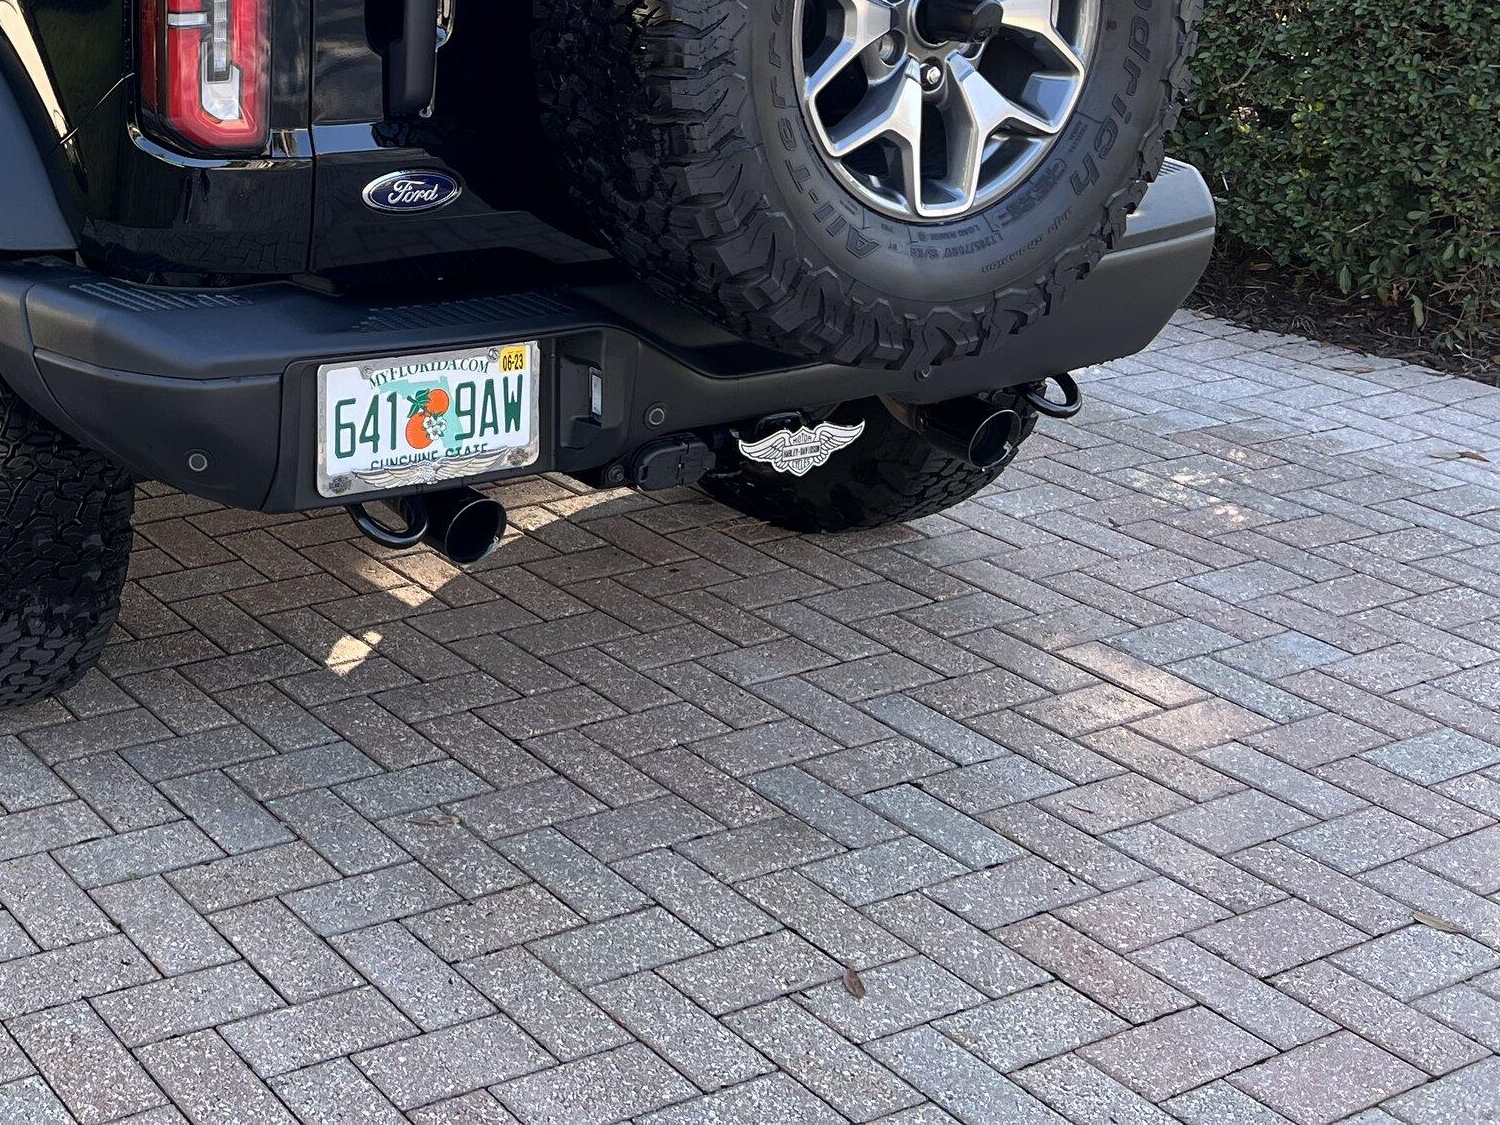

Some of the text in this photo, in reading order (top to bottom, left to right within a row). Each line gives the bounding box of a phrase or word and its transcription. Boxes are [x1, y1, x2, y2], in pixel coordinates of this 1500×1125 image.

[387, 179, 439, 205] Ford
[369, 352, 524, 390] MYFLORIDA.COM 06-23
[334, 373, 524, 460] 641 9AW
[792, 432, 813, 444] MOTOR
